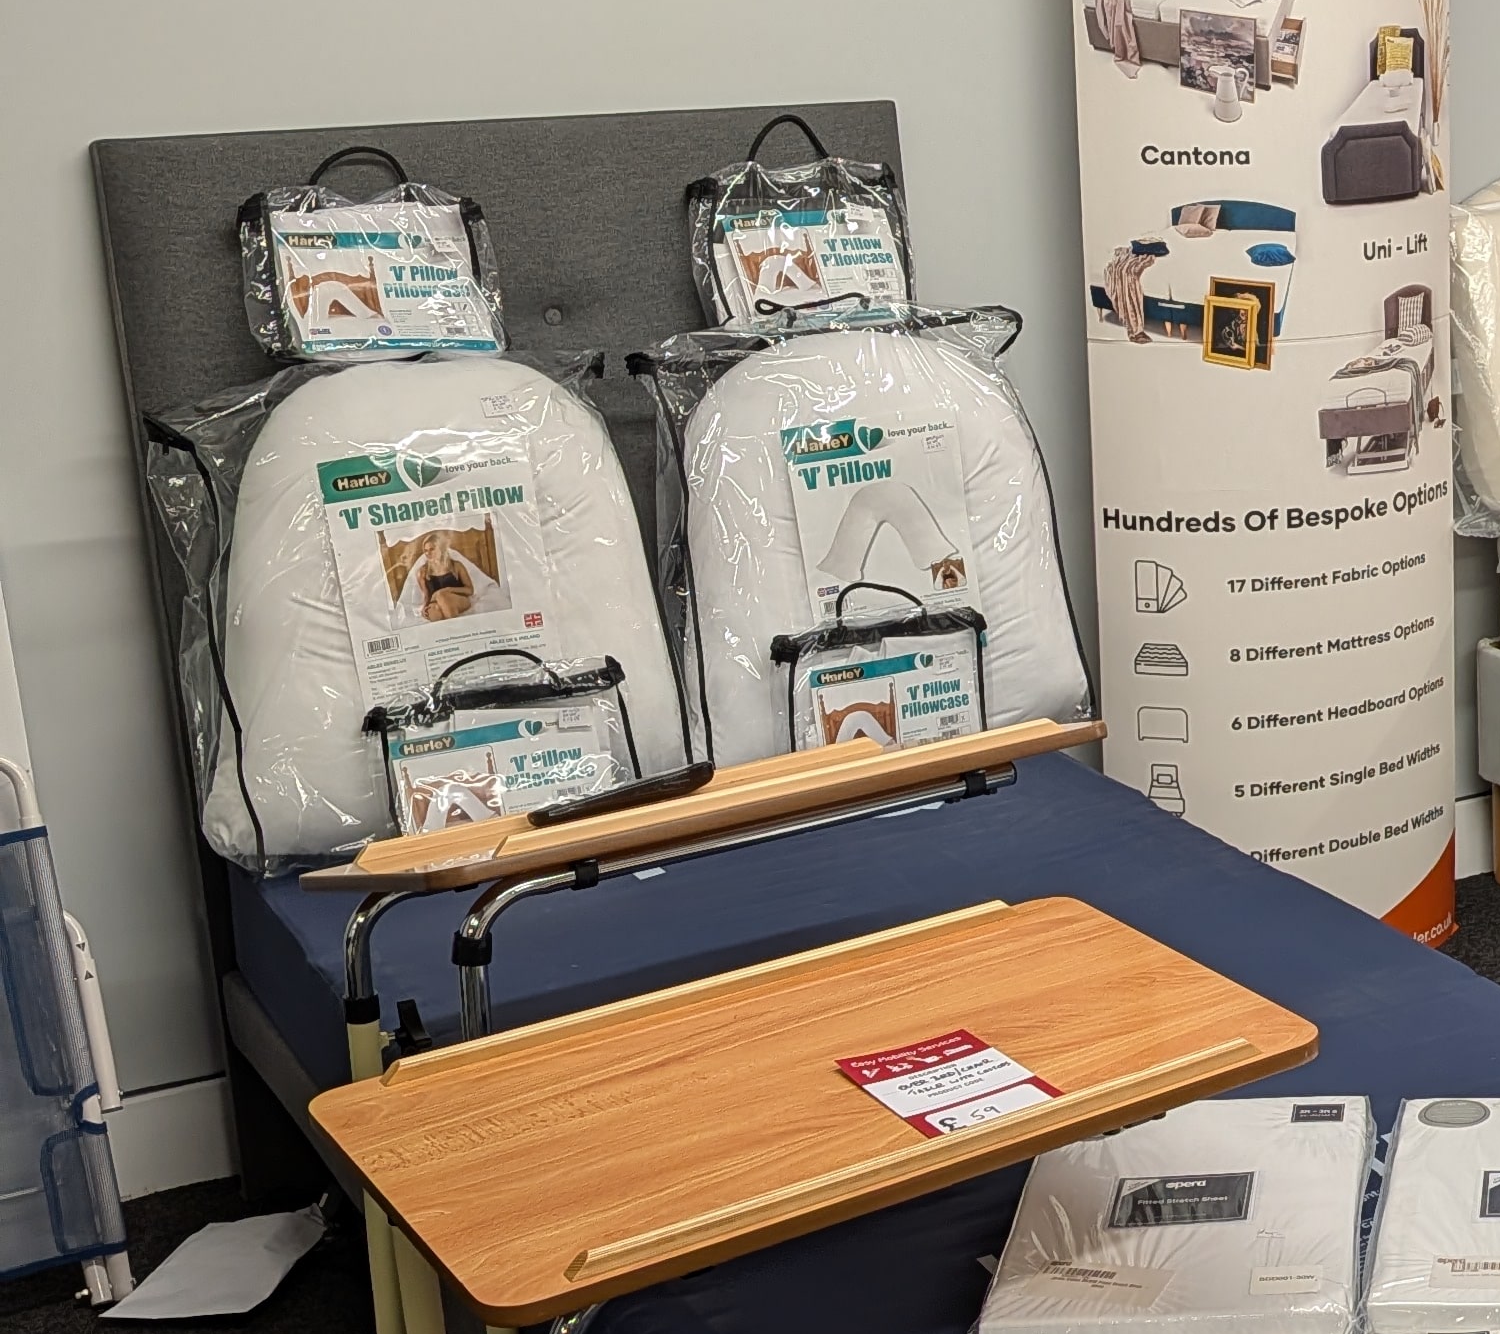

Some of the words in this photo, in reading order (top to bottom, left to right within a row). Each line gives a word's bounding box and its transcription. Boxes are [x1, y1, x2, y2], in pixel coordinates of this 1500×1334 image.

[1140, 146, 1251, 166] Cantona
[842, 236, 882, 252] Pillow
[1363, 241, 1393, 261] Uni
[1406, 234, 1428, 255] Lift
[820, 251, 894, 268] Pillowcase
[410, 264, 458, 283] Pillow
[887, 428, 906, 438] love
[907, 425, 927, 437] your
[445, 464, 465, 474] love
[467, 459, 489, 473] your
[827, 458, 892, 487] Pillow
[368, 492, 454, 527] Shaped
[456, 485, 524, 512] Pillow
[1102, 508, 1236, 533] Hundreds
[1244, 507, 1279, 531] Of
[1287, 497, 1388, 529] Bespoke
[1393, 480, 1448, 514] Options
[1227, 579, 1246, 594] 17
[1251, 573, 1328, 593] Different
[1332, 563, 1379, 584] Fabric
[1382, 552, 1426, 578] Options
[1230, 648, 1241, 663] 8
[1246, 641, 1323, 662] Different
[1327, 629, 1391, 653] Mattress
[1394, 615, 1435, 642] Options
[922, 678, 961, 698] Pillow
[901, 693, 970, 719] Pillowcase
[1231, 716, 1243, 731] 6
[1247, 708, 1323, 730] Different
[1327, 690, 1406, 720] Headboard
[1408, 676, 1444, 703] Options
[531, 747, 582, 769] Pillow
[1234, 784, 1245, 798] 5
[1250, 776, 1325, 797] Different
[1330, 765, 1376, 791] Single
[1379, 755, 1404, 776] Bed
[1406, 742, 1441, 767] Widths
[1251, 841, 1325, 863] Different
[1329, 830, 1381, 853] Double
[1384, 820, 1409, 839] Bed
[1411, 805, 1444, 831] Widths
[850, 1059, 876, 1069] Easy
[878, 1050, 917, 1063] Mobility
[918, 1036, 962, 1052] Services
[938, 1117, 968, 1131] £
[970, 1105, 1001, 1121] 59
[1166, 1179, 1207, 1190] opera
